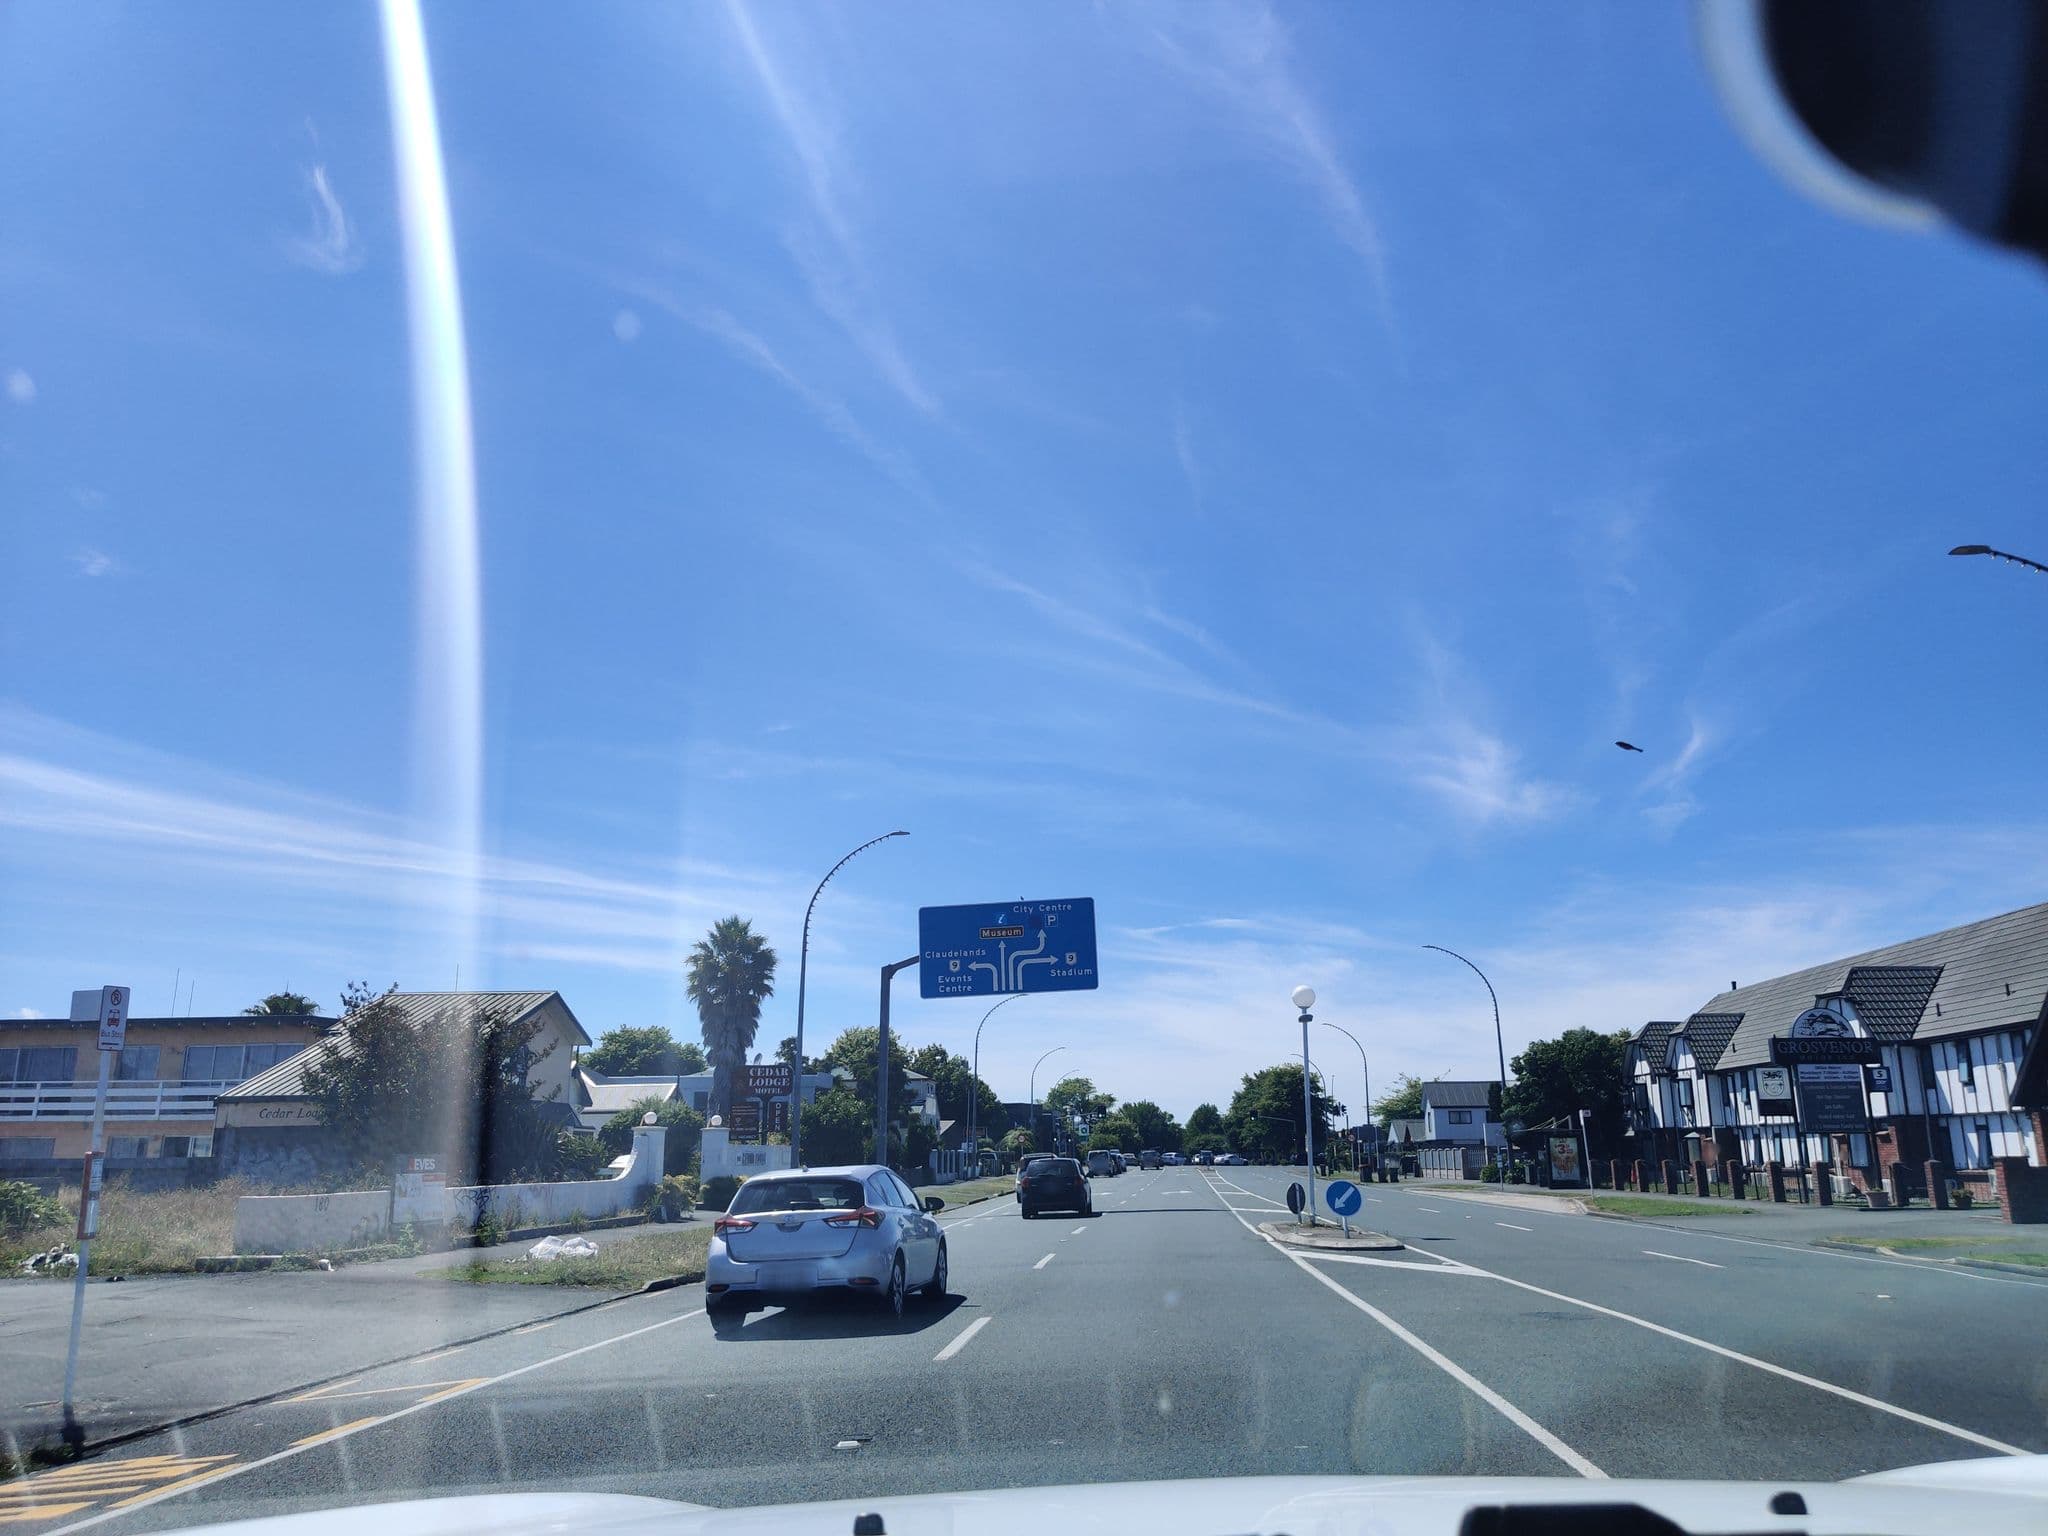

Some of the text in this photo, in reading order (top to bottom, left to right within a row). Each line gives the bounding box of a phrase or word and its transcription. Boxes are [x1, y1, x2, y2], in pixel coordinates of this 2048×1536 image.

[1013, 904, 1072, 915] City Centre
[1047, 915, 1056, 926] P
[981, 928, 1022, 938] Museum
[925, 949, 987, 959] Claudelands
[1067, 954, 1074, 963] 9
[951, 961, 959, 970] 9
[1050, 967, 1093, 977] Stadium
[938, 975, 973, 983] Events
[938, 984, 973, 993] Centre
[1777, 1041, 1874, 1054] GROSVENOR
[749, 1067, 789, 1077] CEDAR
[749, 1077, 790, 1087] LODGE
[259, 1107, 320, 1119] Cedar Lod
